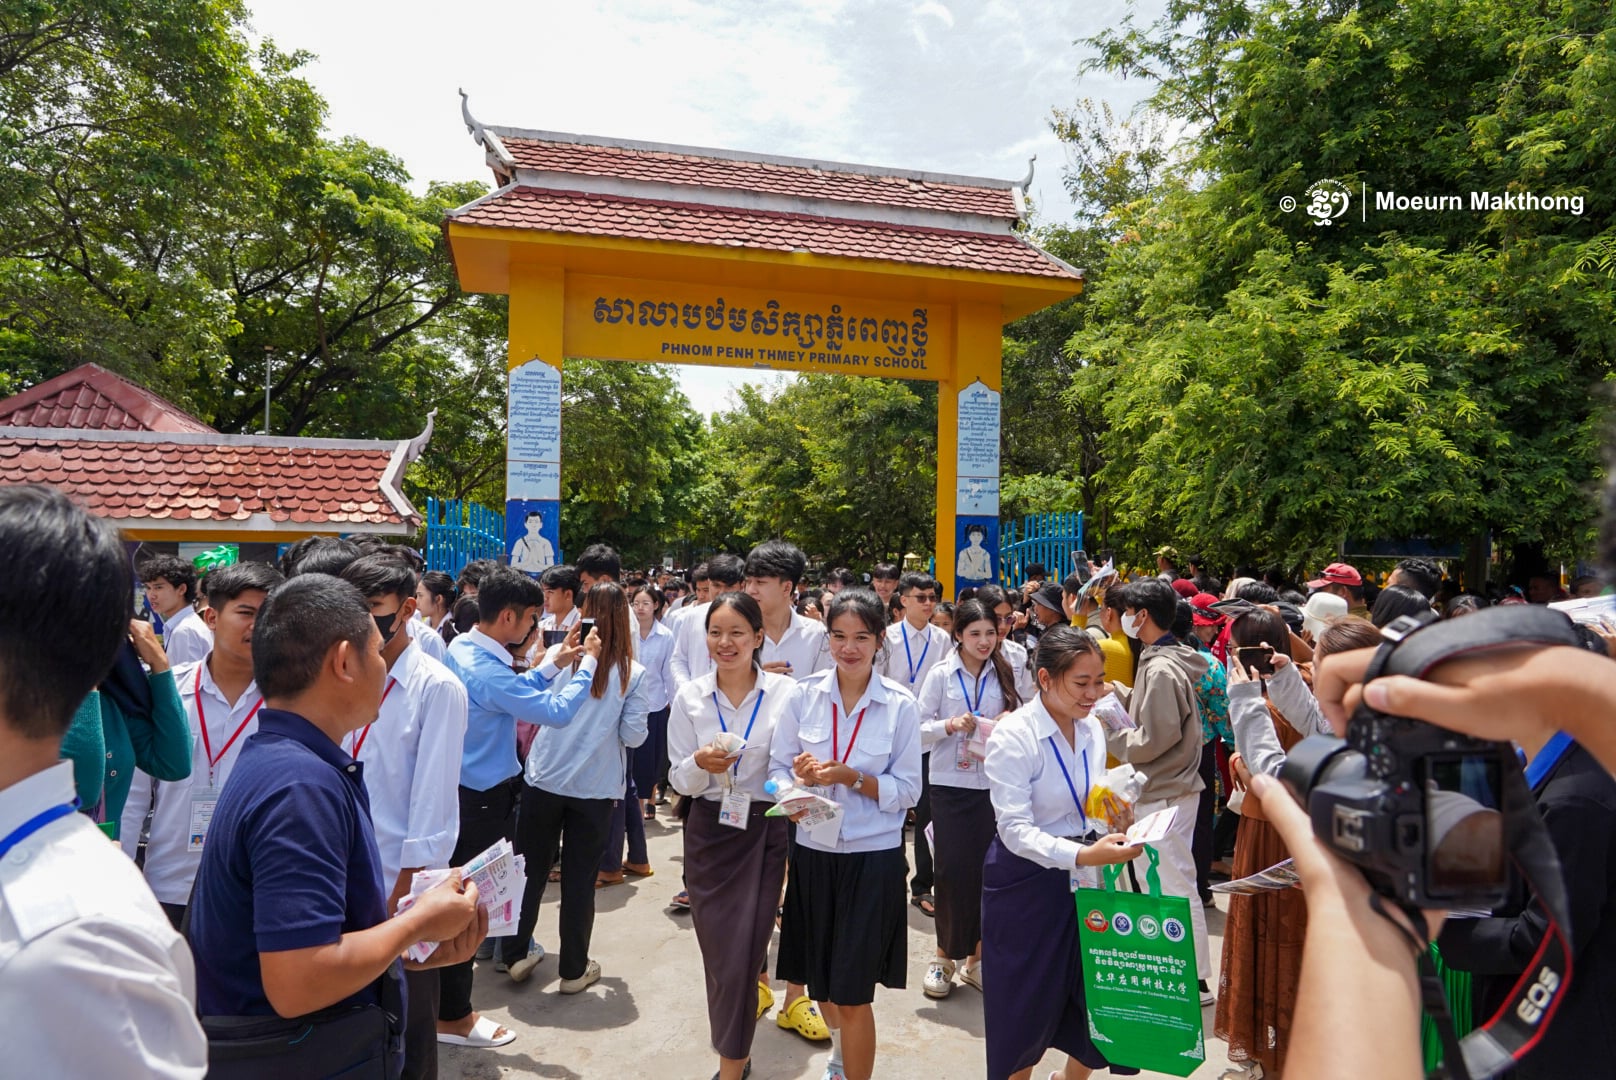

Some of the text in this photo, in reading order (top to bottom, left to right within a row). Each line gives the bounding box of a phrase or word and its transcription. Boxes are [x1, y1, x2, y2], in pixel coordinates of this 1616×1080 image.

[661, 342, 928, 370] PHNOM PENH THMEY PRIMARY SCHOOL
[1516, 965, 1560, 1025] EOS
